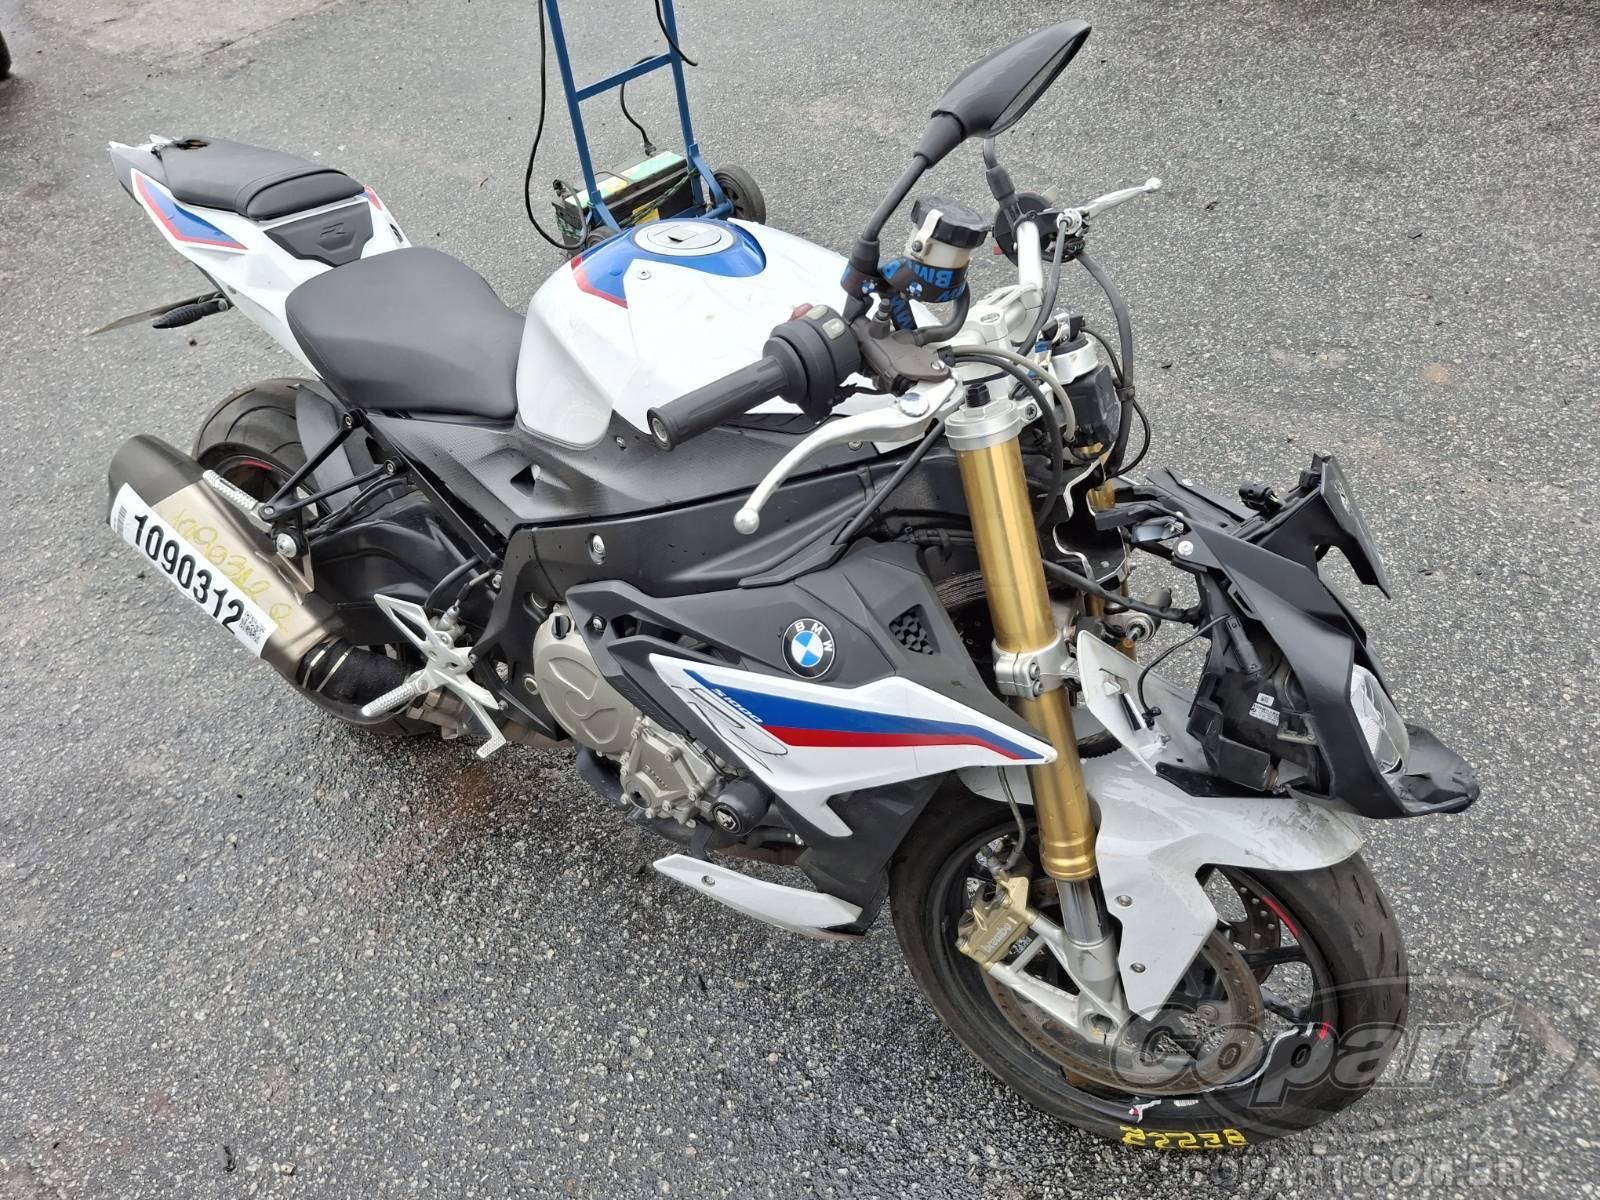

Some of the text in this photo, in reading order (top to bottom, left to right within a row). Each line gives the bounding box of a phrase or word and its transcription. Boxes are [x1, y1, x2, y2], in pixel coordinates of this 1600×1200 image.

[134, 513, 245, 635] 1090312
[794, 621, 833, 652] BMW
[983, 922, 1013, 954] brembo
